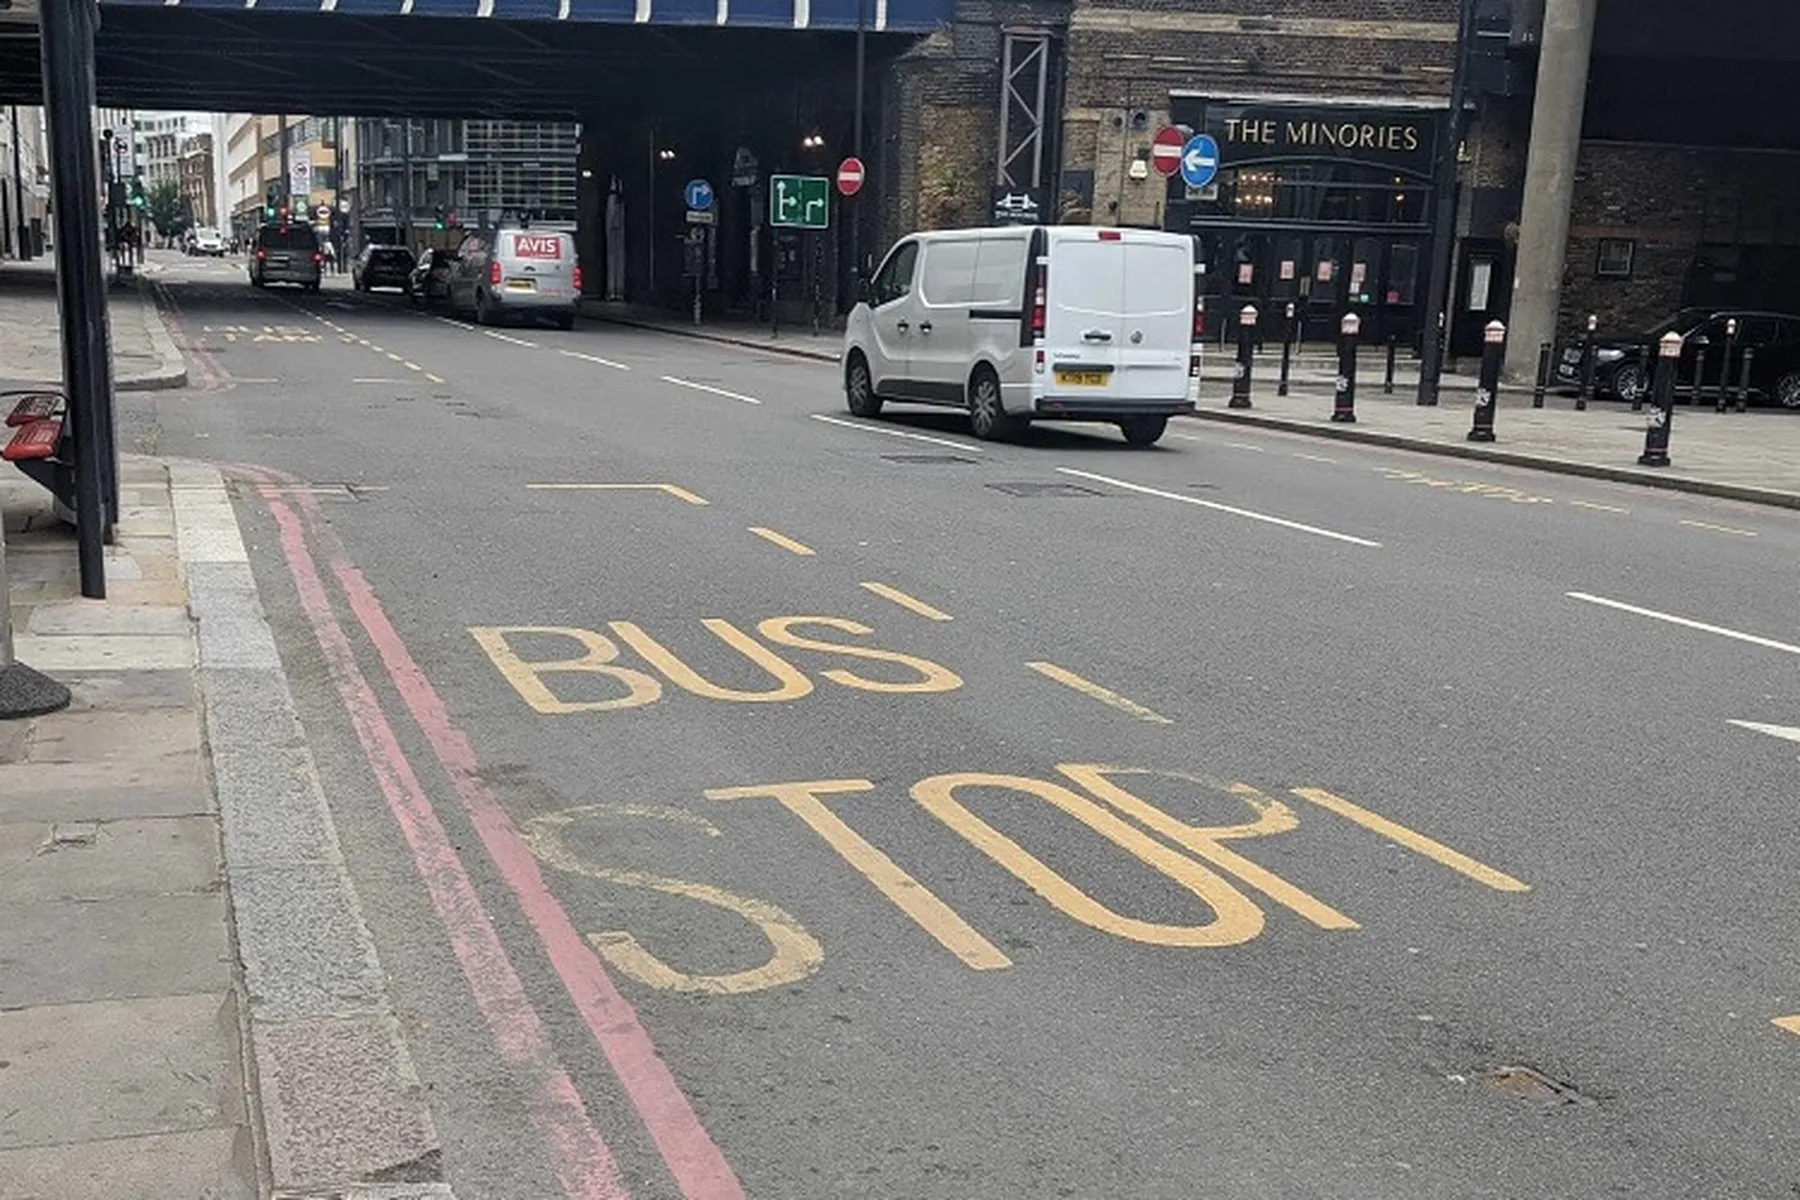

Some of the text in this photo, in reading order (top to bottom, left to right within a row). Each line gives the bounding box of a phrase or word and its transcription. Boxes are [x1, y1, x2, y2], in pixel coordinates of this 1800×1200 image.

[1225, 118, 1419, 151] THE MINORIES
[517, 237, 557, 253] AVIS
[468, 615, 963, 715] BUS
[519, 763, 1362, 995] STOP
